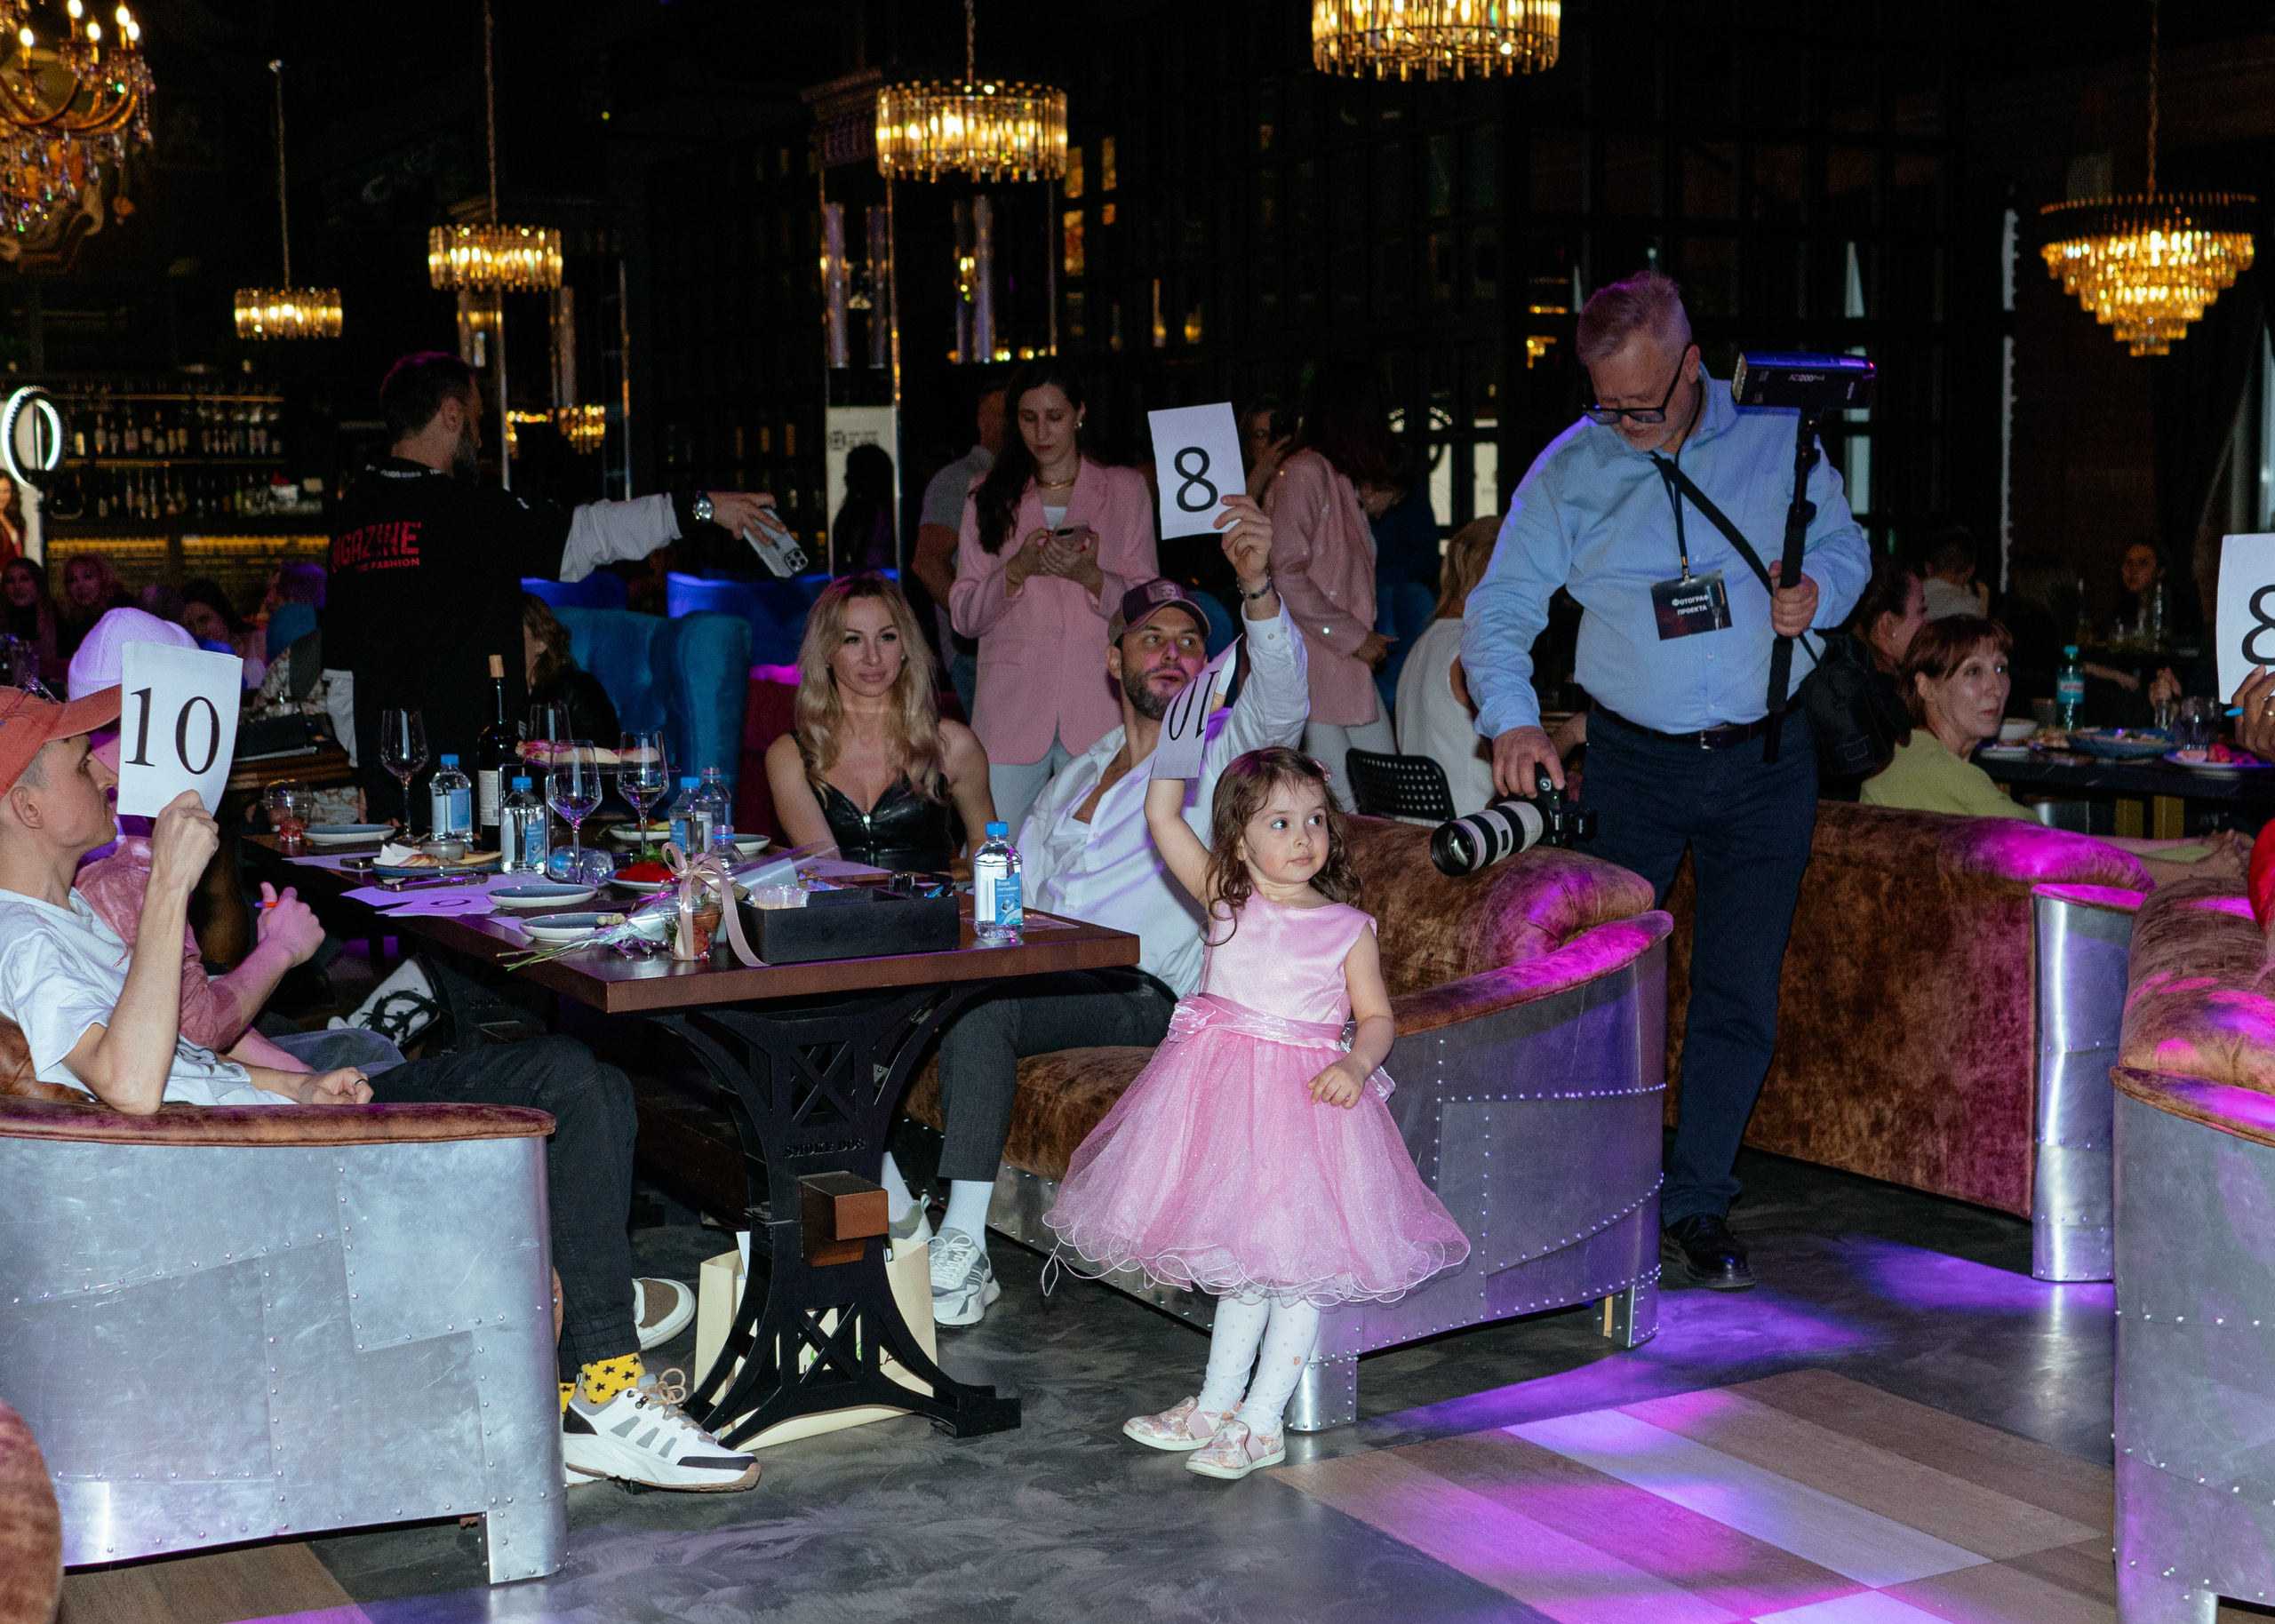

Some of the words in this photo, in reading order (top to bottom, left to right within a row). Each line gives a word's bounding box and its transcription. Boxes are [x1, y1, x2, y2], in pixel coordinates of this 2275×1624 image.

[1174, 446, 1218, 513] 8
[371, 558, 420, 569] FASHION
[1677, 605, 1707, 616] ПРОЕКТА
[2241, 584, 2275, 666] 8
[124, 687, 220, 776] 10
[785, 1141, 834, 1158] SMOKE
